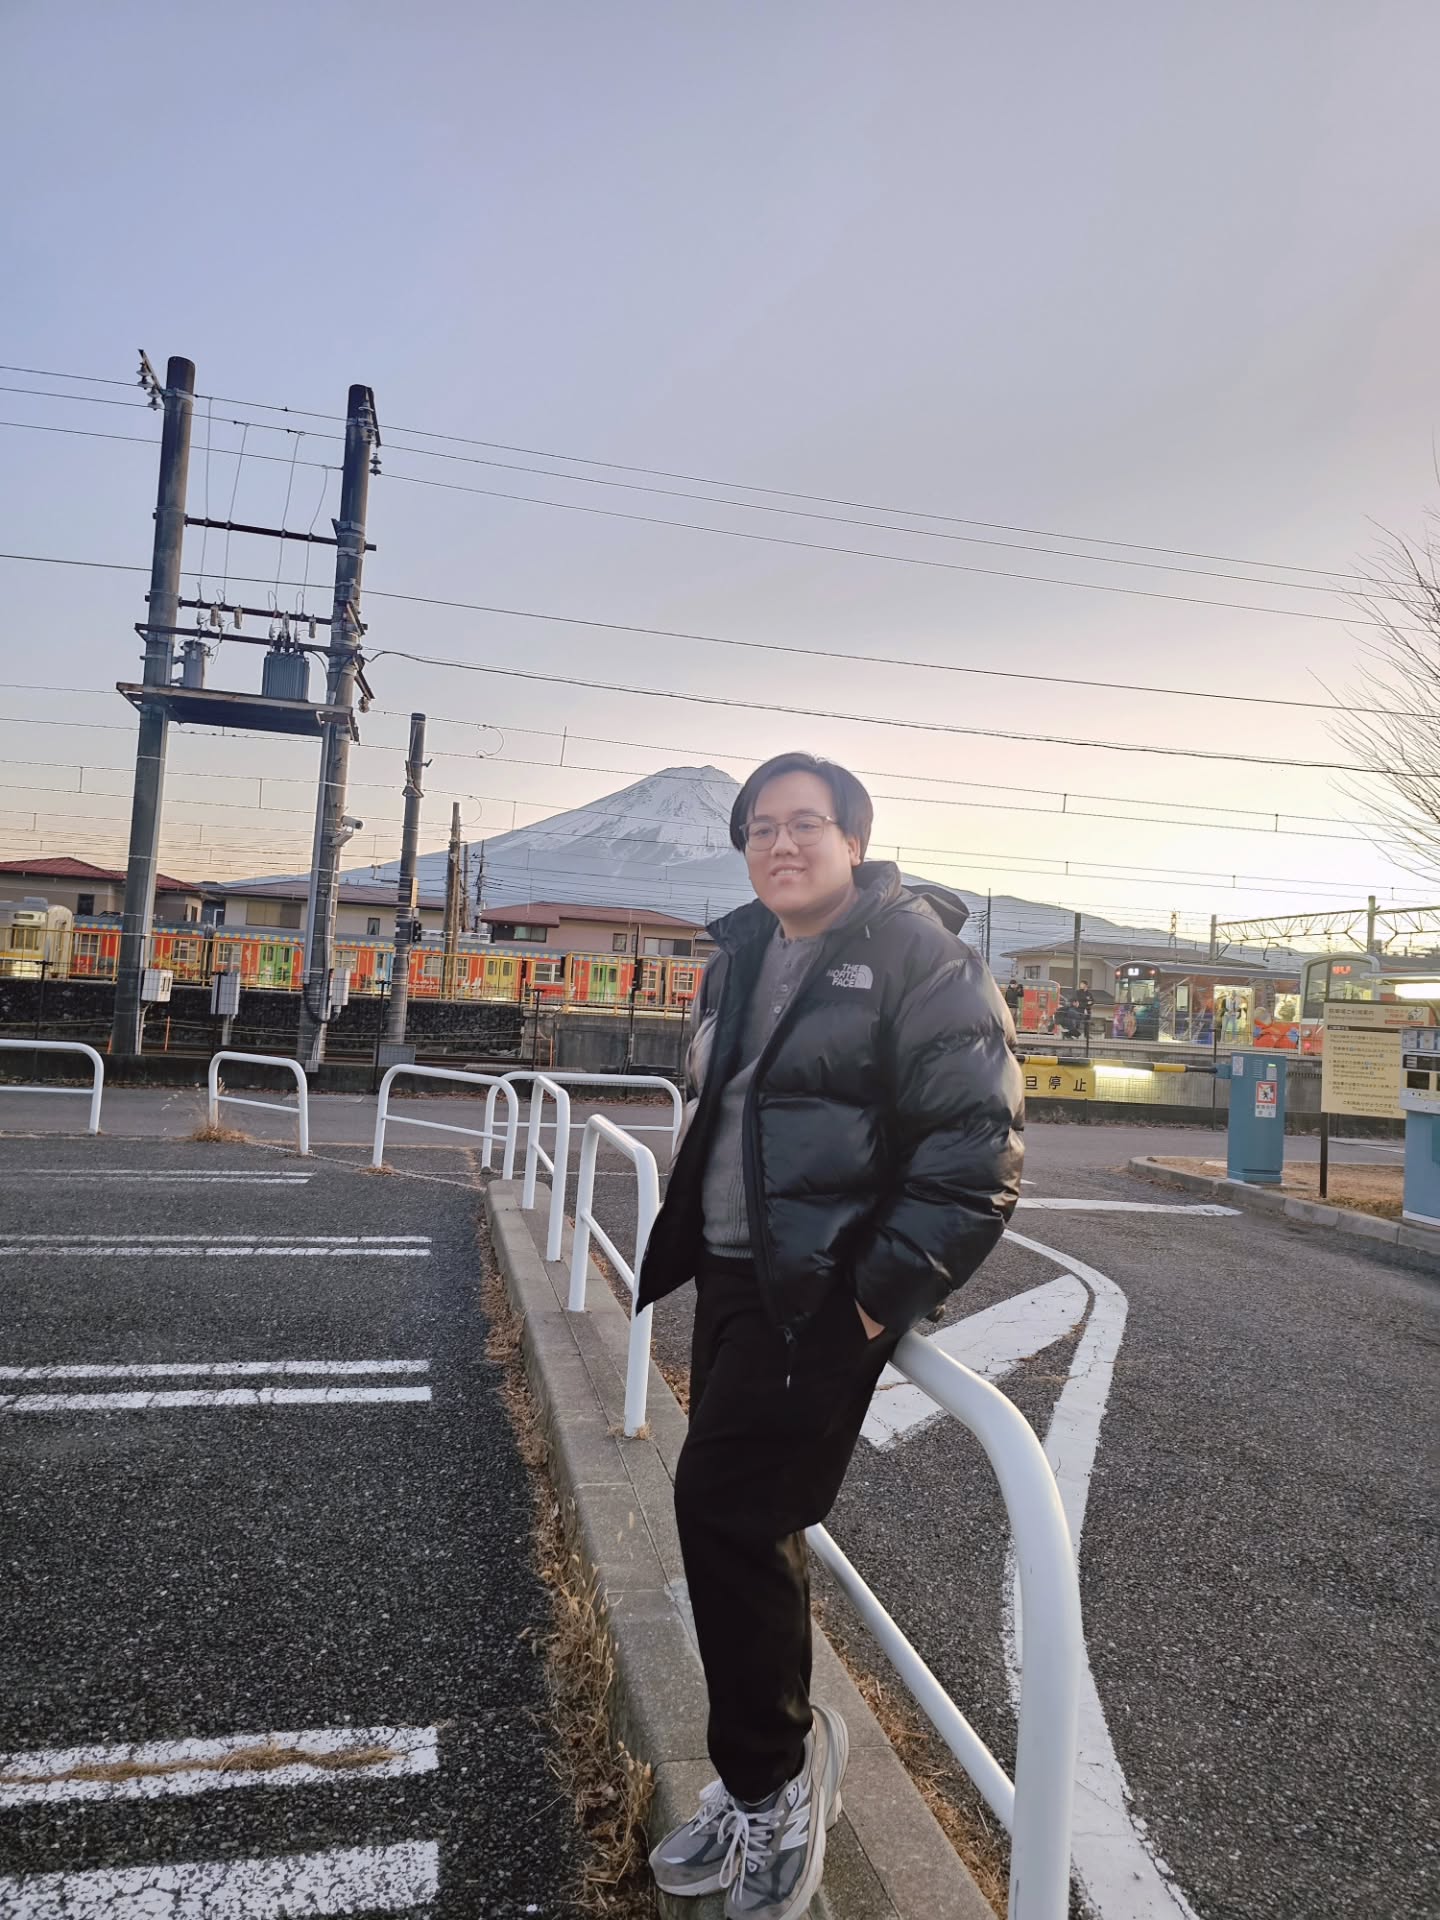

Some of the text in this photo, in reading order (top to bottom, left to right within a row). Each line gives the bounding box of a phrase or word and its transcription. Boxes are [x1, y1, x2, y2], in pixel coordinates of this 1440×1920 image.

[843, 964, 860, 972] THE
[827, 970, 857, 978] NORTH
[832, 978, 855, 987] FACE
